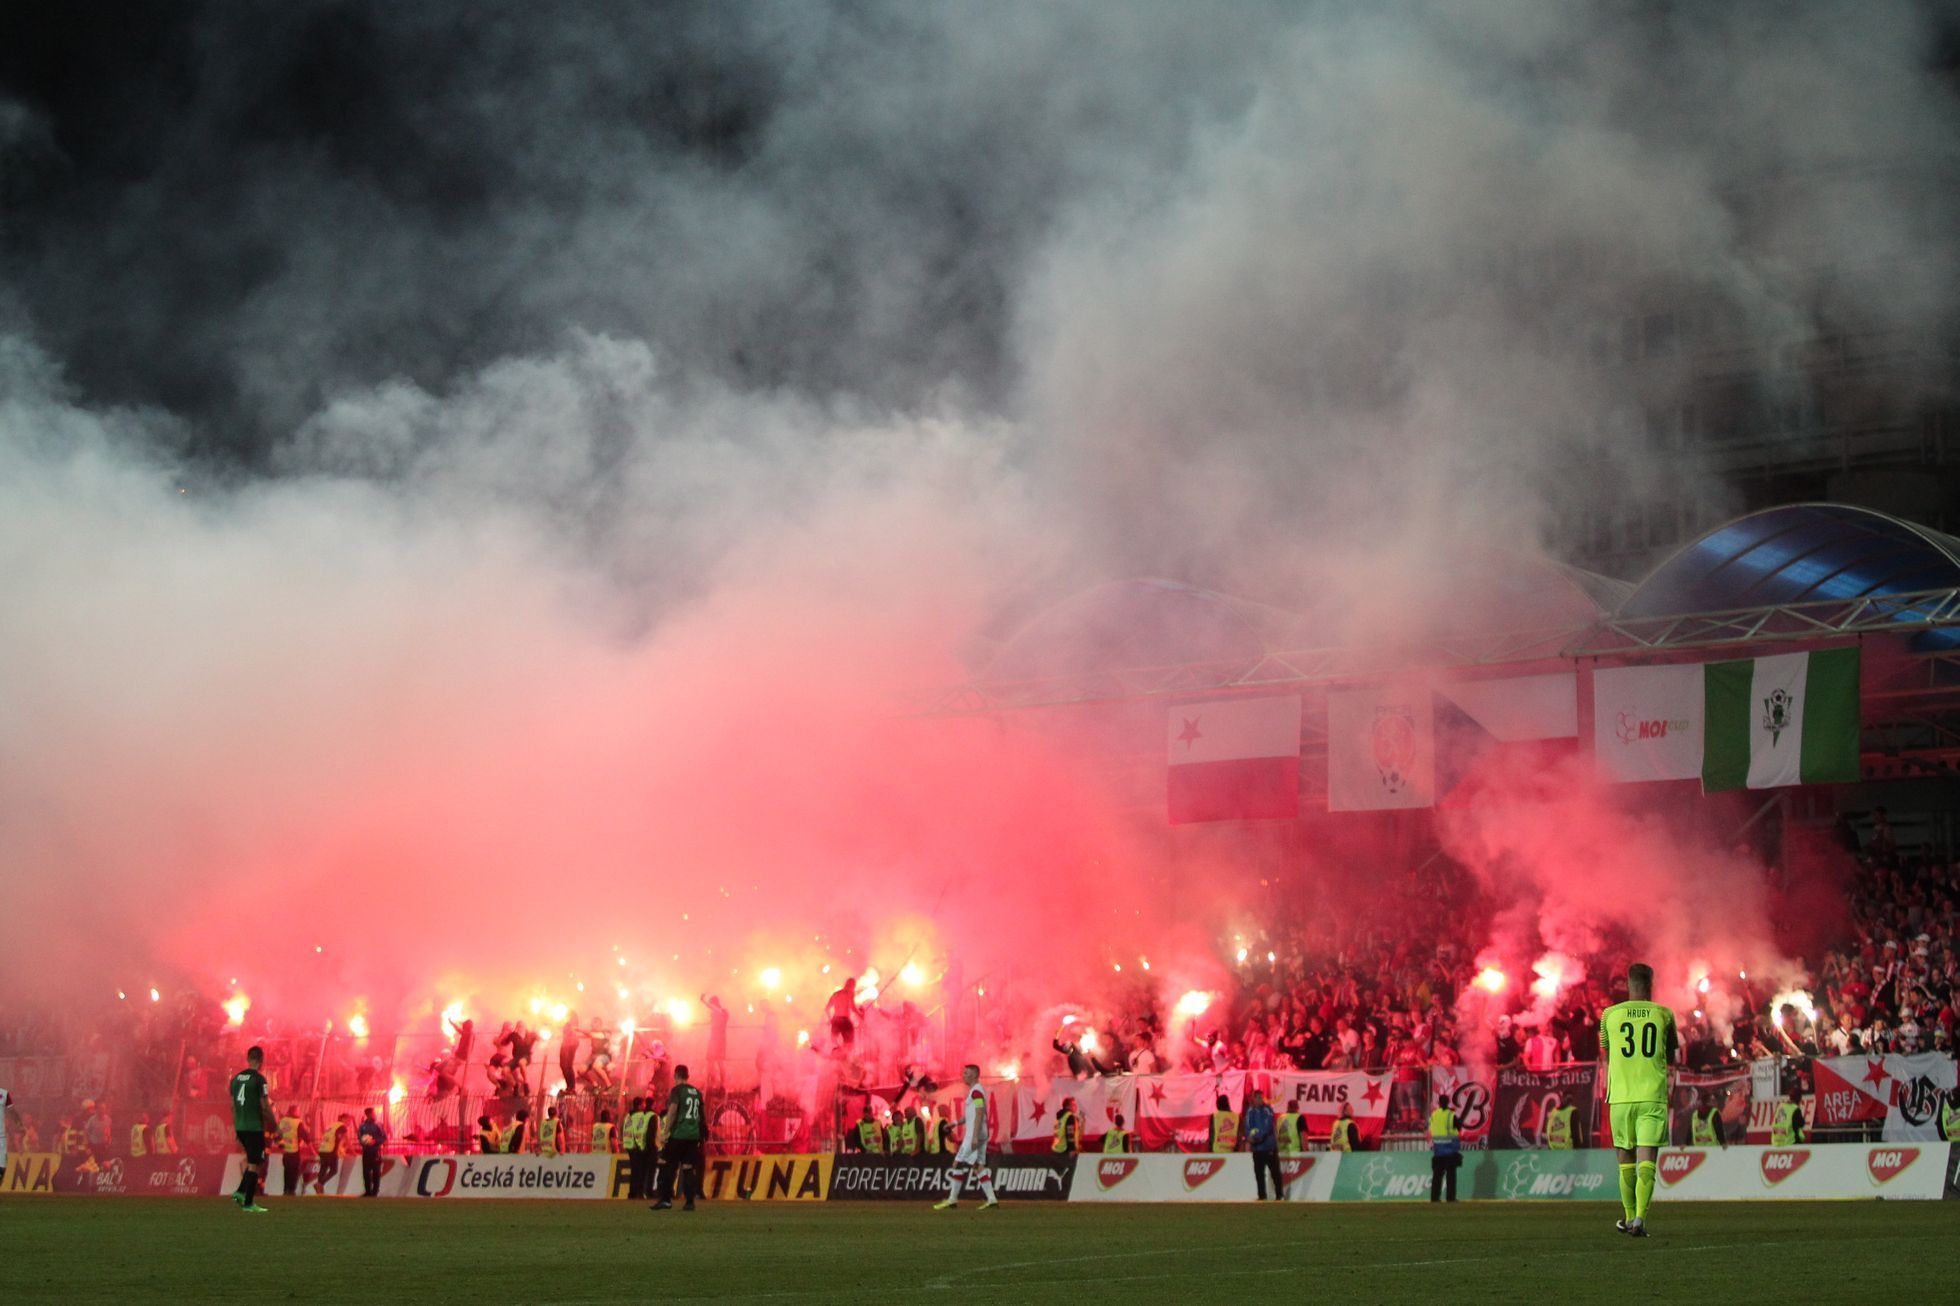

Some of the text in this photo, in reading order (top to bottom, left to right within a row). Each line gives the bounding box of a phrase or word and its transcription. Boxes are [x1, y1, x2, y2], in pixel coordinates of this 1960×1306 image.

[1639, 719, 1668, 739] MOL
[1620, 1022, 1657, 1058] 30
[237, 1083, 246, 1106] 4
[1296, 1083, 1349, 1102] FANS
[1824, 1090, 1862, 1109] AREA
[685, 1097, 701, 1119] 26
[1101, 1162, 1125, 1175] MOL
[1187, 1162, 1212, 1175] MOL
[1663, 1156, 1690, 1171] MOL
[1766, 1154, 1793, 1169] MOL
[1872, 1152, 1902, 1168] MOL
[461, 1162, 595, 1189] Česká televize
[612, 1160, 821, 1200] FTUNA
[994, 1168, 1047, 1191] PUMA
[1383, 1175, 1426, 1195] MOL
[1530, 1174, 1604, 1195] MOL cup
